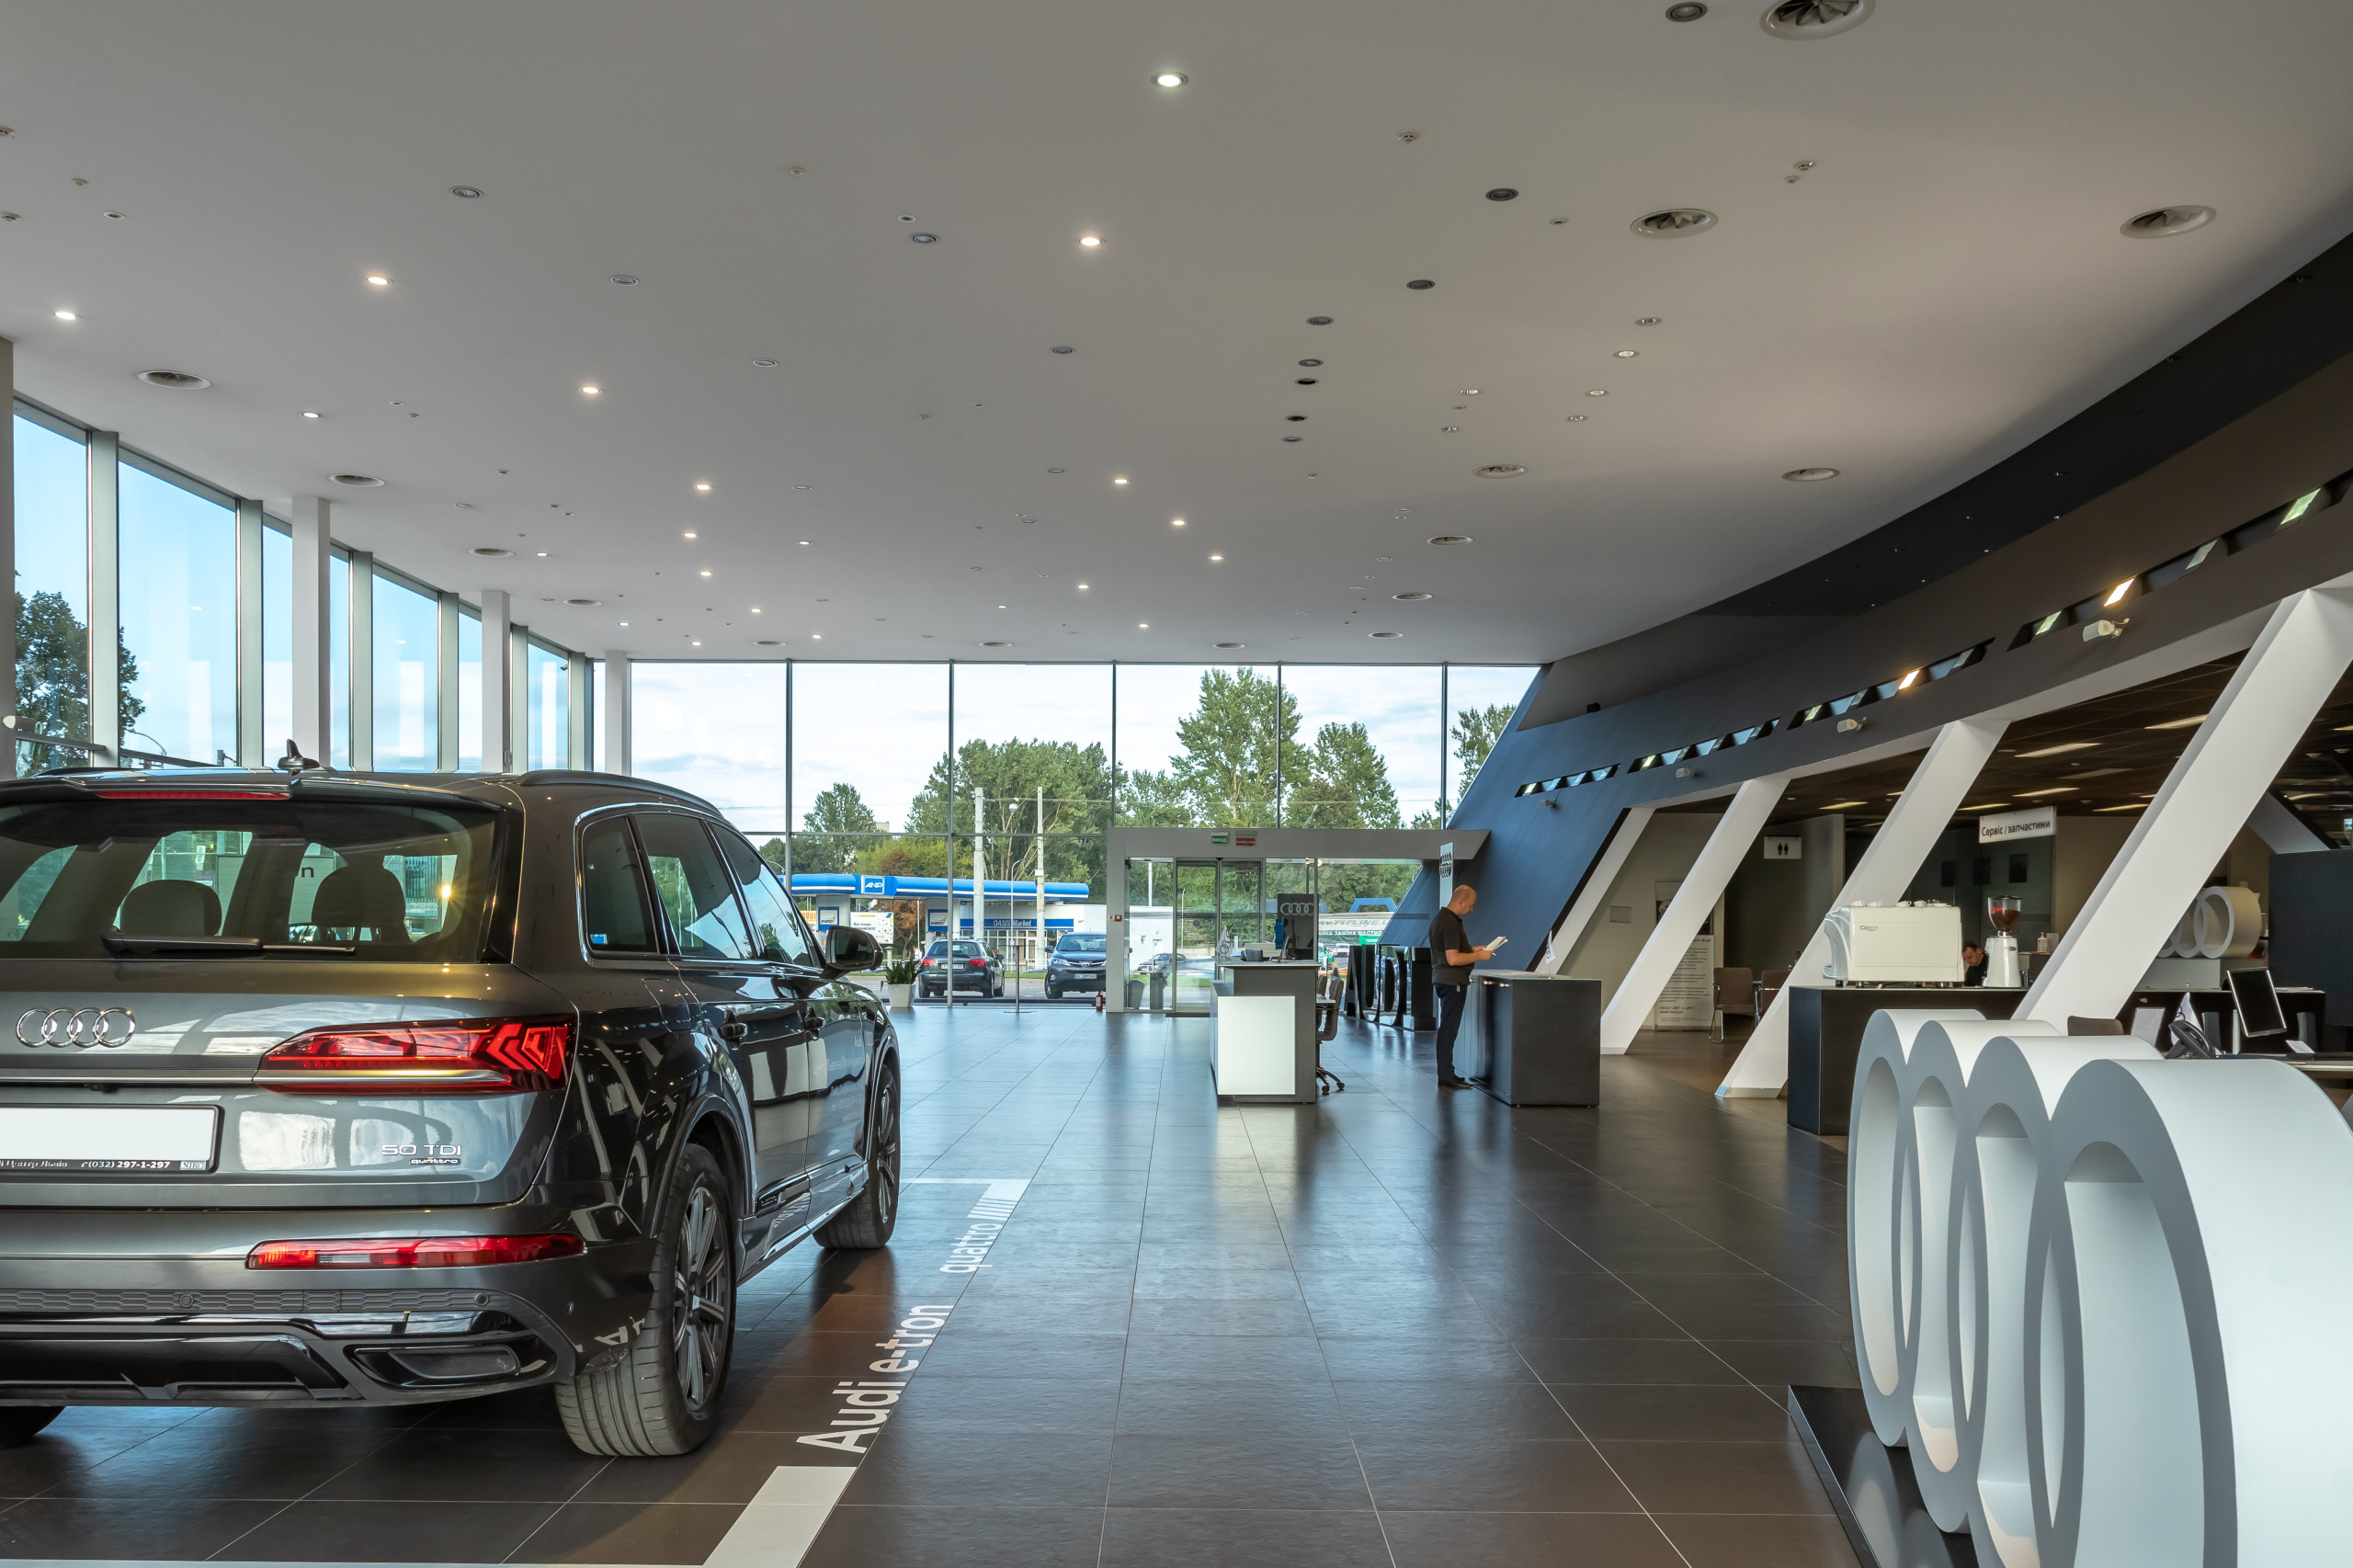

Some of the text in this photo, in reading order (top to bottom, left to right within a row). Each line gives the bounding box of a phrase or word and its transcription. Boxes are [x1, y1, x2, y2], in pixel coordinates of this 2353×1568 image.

[1981, 824, 2004, 837] Сервіс
[2007, 821, 2051, 834] запчастини
[381, 1144, 461, 1156] 50 TDI
[88, 1160, 115, 1169] (032)
[796, 1222, 1004, 1454] Audi e-tron quattro
